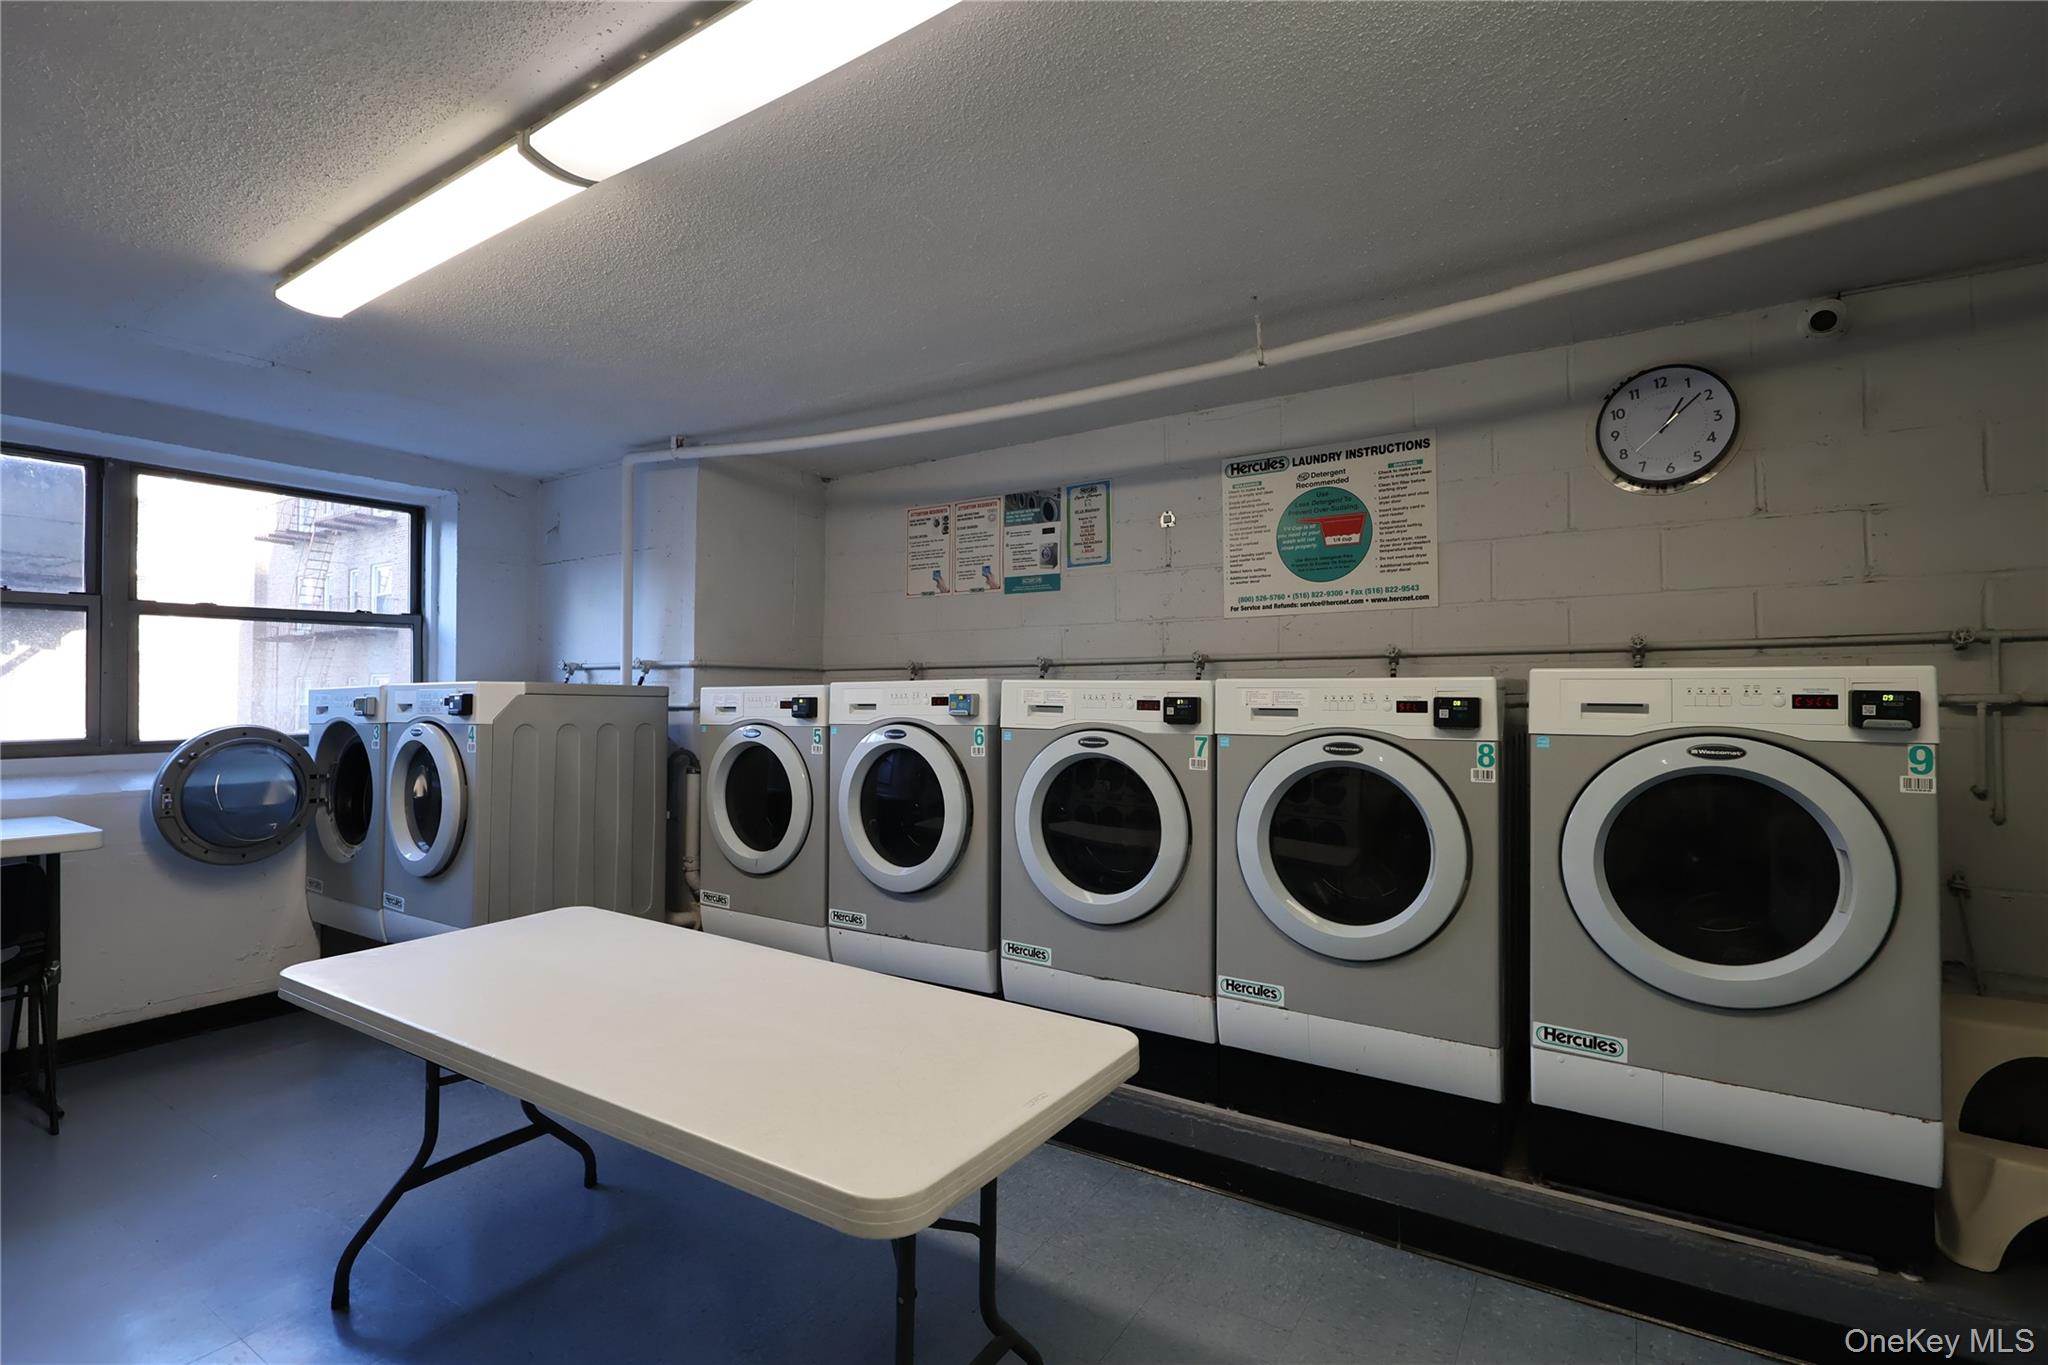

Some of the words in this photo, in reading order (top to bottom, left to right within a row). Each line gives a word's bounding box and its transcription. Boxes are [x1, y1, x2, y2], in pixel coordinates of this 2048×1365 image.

[1654, 377, 1668, 389] 12
[1685, 377, 1691, 388] 1
[1629, 389, 1640, 400] 11
[1704, 389, 1714, 401] 2
[1611, 408, 1625, 420] 10
[1713, 410, 1723, 421] 3
[1611, 430, 1620, 441] 9
[1706, 432, 1717, 442] 4
[1230, 458, 1285, 476] Hercules
[1292, 452, 1342, 467] LAUNDRY
[1346, 438, 1430, 460] INSTRUCTIONS
[1619, 449, 1628, 460] 8
[1693, 451, 1702, 462] 5
[1638, 461, 1647, 472] 7
[1666, 463, 1675, 474] 6
[1311, 469, 1346, 478] Detergent
[1296, 476, 1349, 488] Recommended
[1293, 592, 1309, 600] (516)
[1312, 590, 1343, 598] 822-9300
[1365, 587, 1383, 595] (516)
[1385, 584, 1419, 593] 822-9543
[1300, 598, 1364, 607] service@hercnet.com
[1371, 594, 1429, 603] www.hercnet.com
[374, 726, 379, 739] 3
[468, 727, 474, 741] 4
[814, 729, 821, 743] 5
[974, 729, 984, 746] 6
[1195, 737, 1208, 757] 7
[1478, 744, 1495, 768] 8
[1909, 745, 1933, 775] 9
[703, 892, 727, 904] Hercules
[833, 911, 863, 924] Hercules
[1008, 943, 1046, 960] Hercules
[1226, 979, 1277, 999] Hercules
[1544, 1027, 1617, 1053] Hercules
